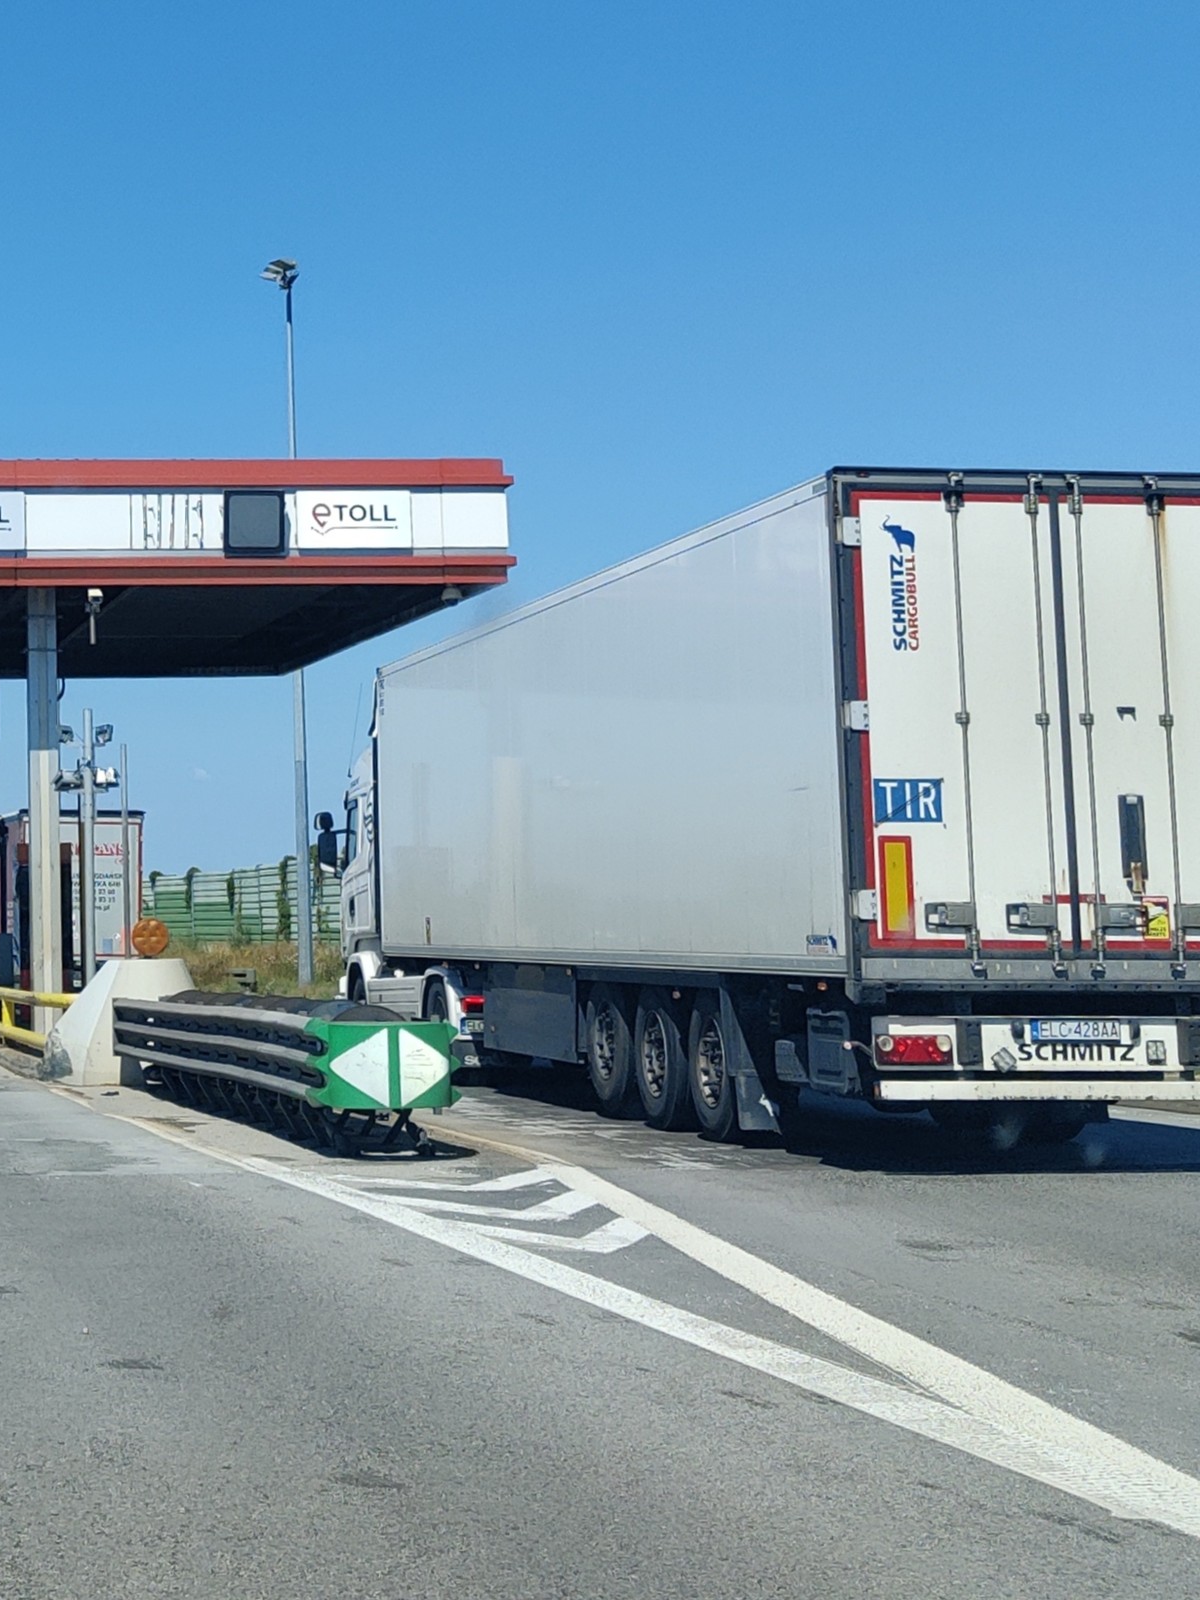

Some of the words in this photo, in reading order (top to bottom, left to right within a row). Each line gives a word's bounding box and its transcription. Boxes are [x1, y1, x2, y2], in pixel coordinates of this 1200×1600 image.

[312, 503, 397, 527] eTOLL
[889, 554, 907, 651] SCHMITZ
[905, 555, 919, 651] CARGOBULL
[878, 782, 937, 819] TIR
[1018, 1043, 1135, 1061] SCHMITZ
